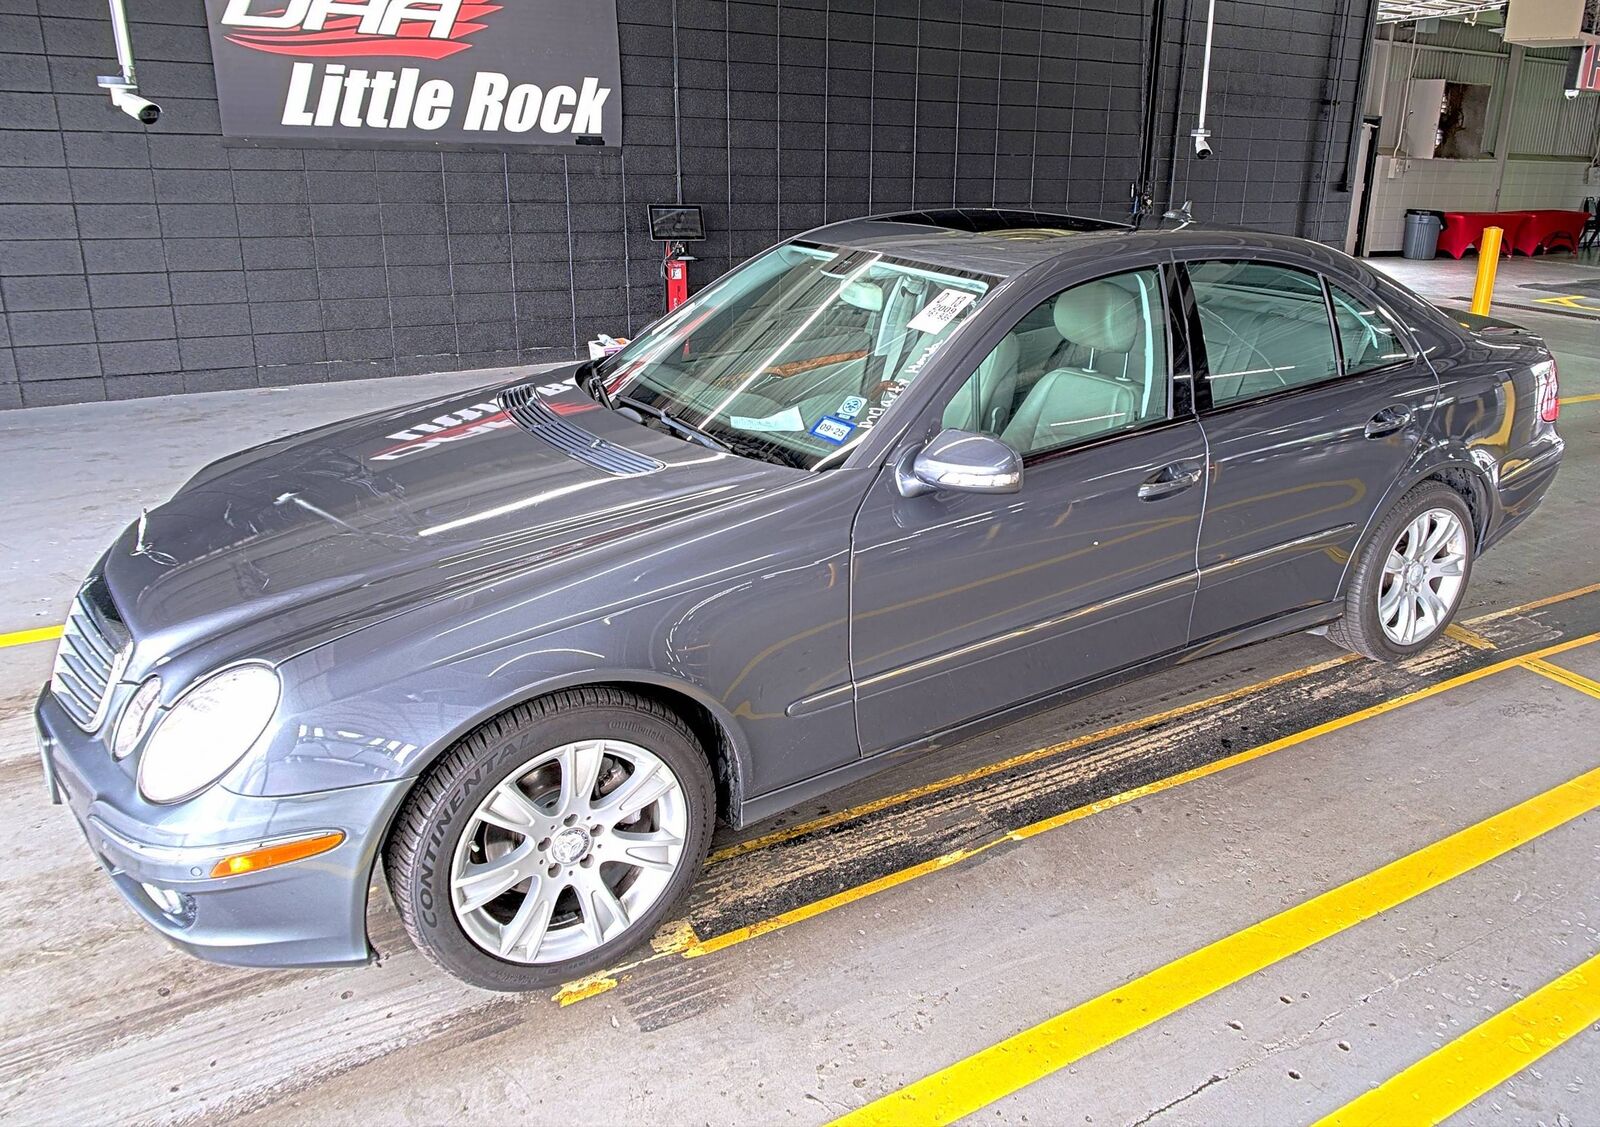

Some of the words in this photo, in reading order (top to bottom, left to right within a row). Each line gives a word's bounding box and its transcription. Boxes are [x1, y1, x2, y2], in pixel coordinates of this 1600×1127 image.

[281, 62, 454, 130] Little
[463, 71, 611, 135] Rock
[420, 732, 537, 929] CONTINENTAL
